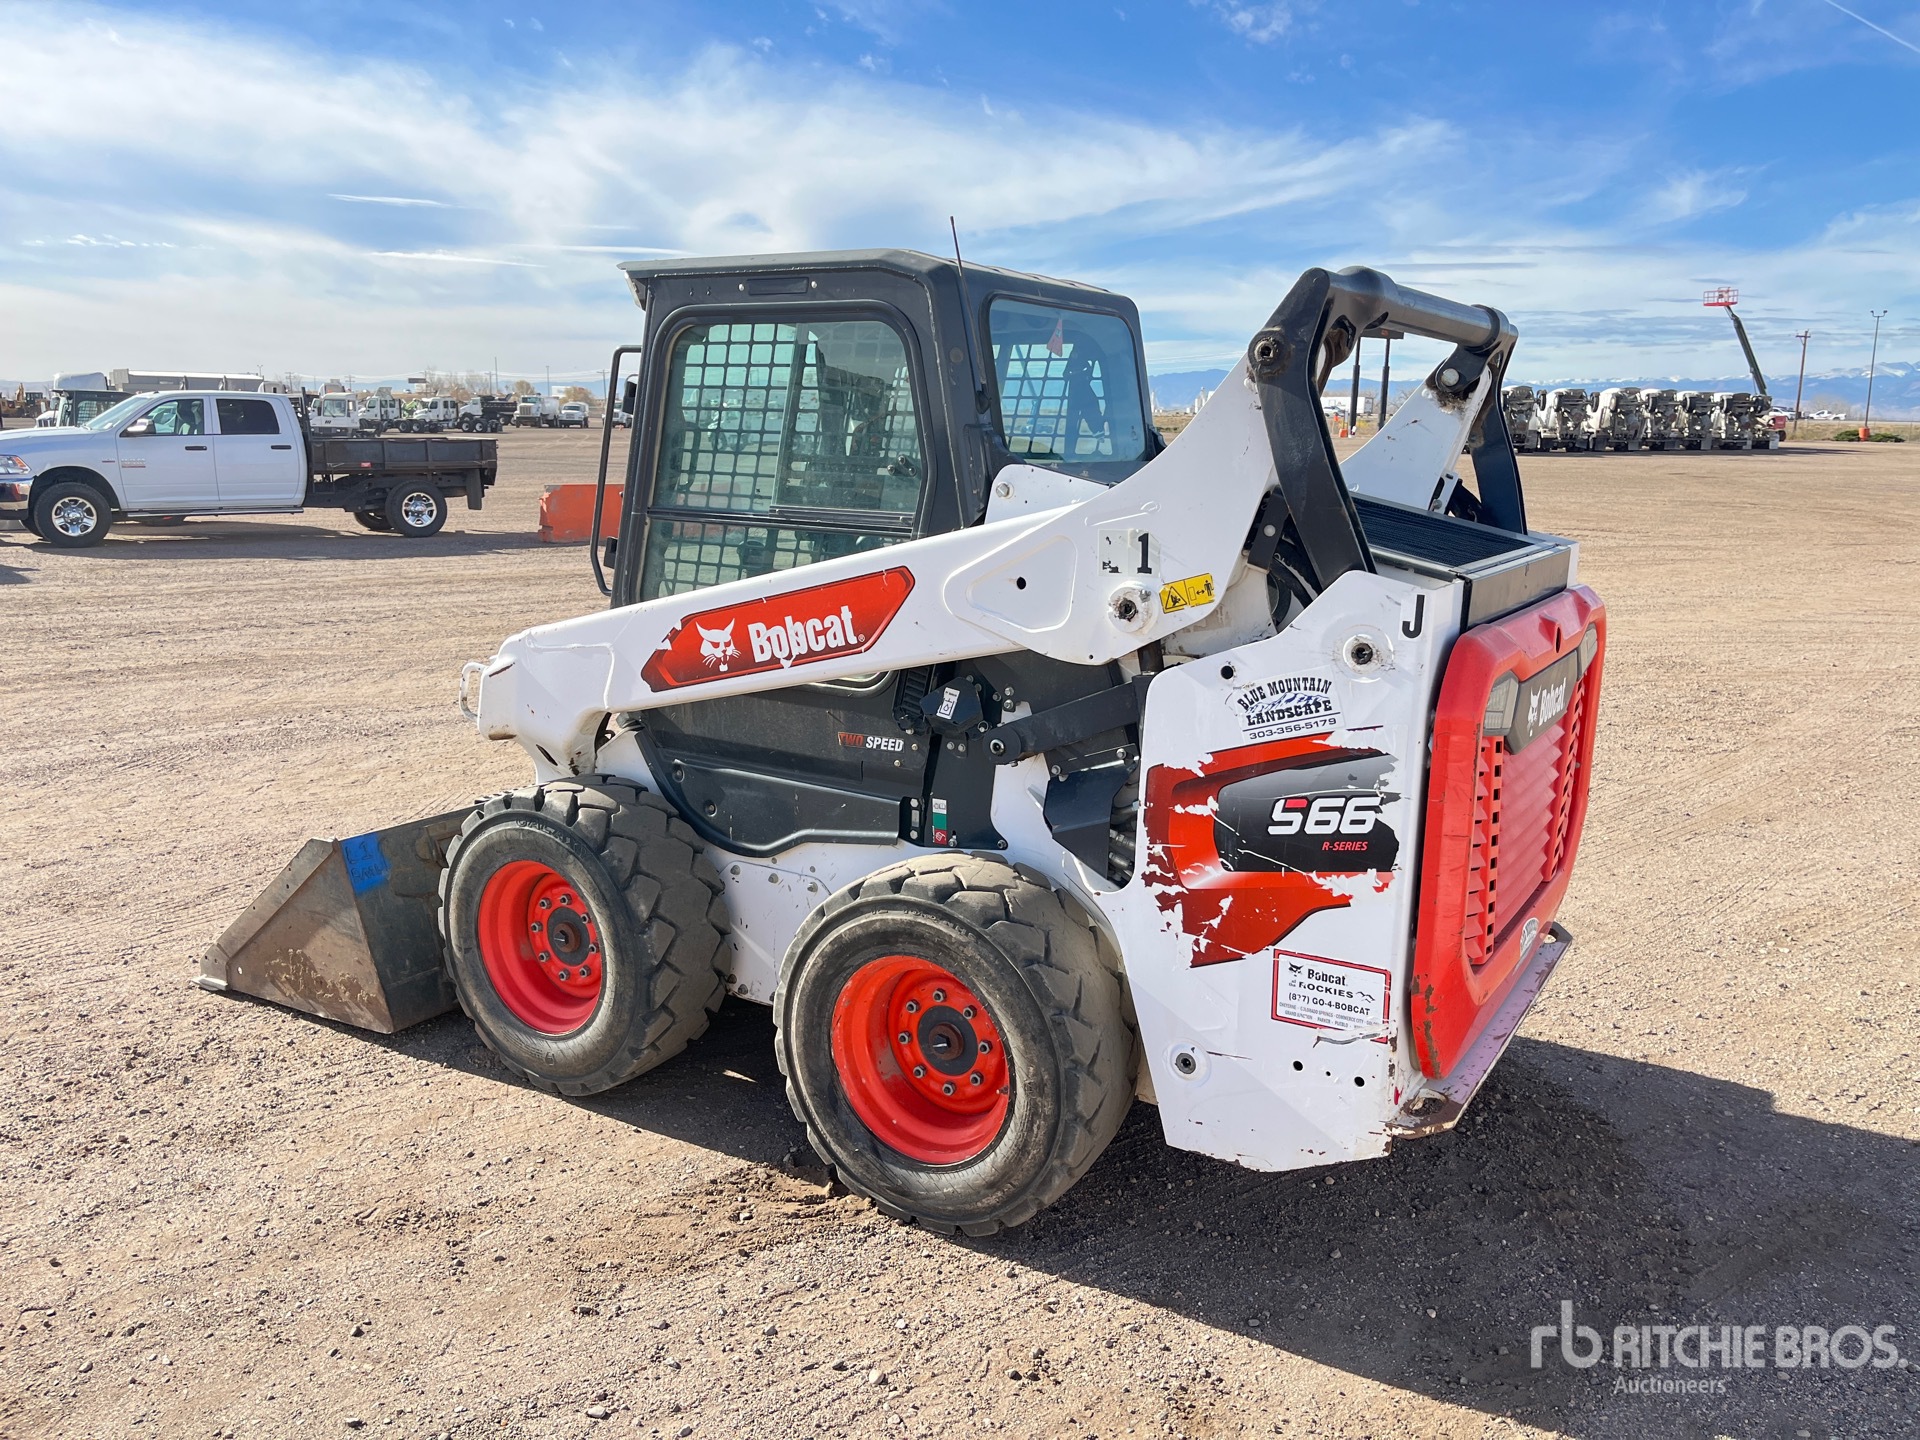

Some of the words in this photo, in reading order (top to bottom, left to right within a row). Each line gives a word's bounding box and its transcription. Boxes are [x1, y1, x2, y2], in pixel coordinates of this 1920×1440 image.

[1402, 594, 1425, 638] J
[748, 605, 857, 663] Bobcat
[1237, 686, 1267, 711] BLUE
[1267, 677, 1332, 696] MOUNTAIN
[1538, 677, 1567, 727] Bobcat
[1246, 700, 1333, 726] LANDSCAPE
[1249, 718, 1337, 739] 303-356-5179
[838, 733, 864, 747] TWO
[866, 736, 904, 751] SPEED
[1267, 797, 1382, 835] S66
[1322, 841, 1368, 851] R-SERIES
[1307, 968, 1346, 986] Bobcat
[1298, 981, 1354, 999] ROCKIES
[1312, 997, 1370, 1016] GO-4-BOBCAT
